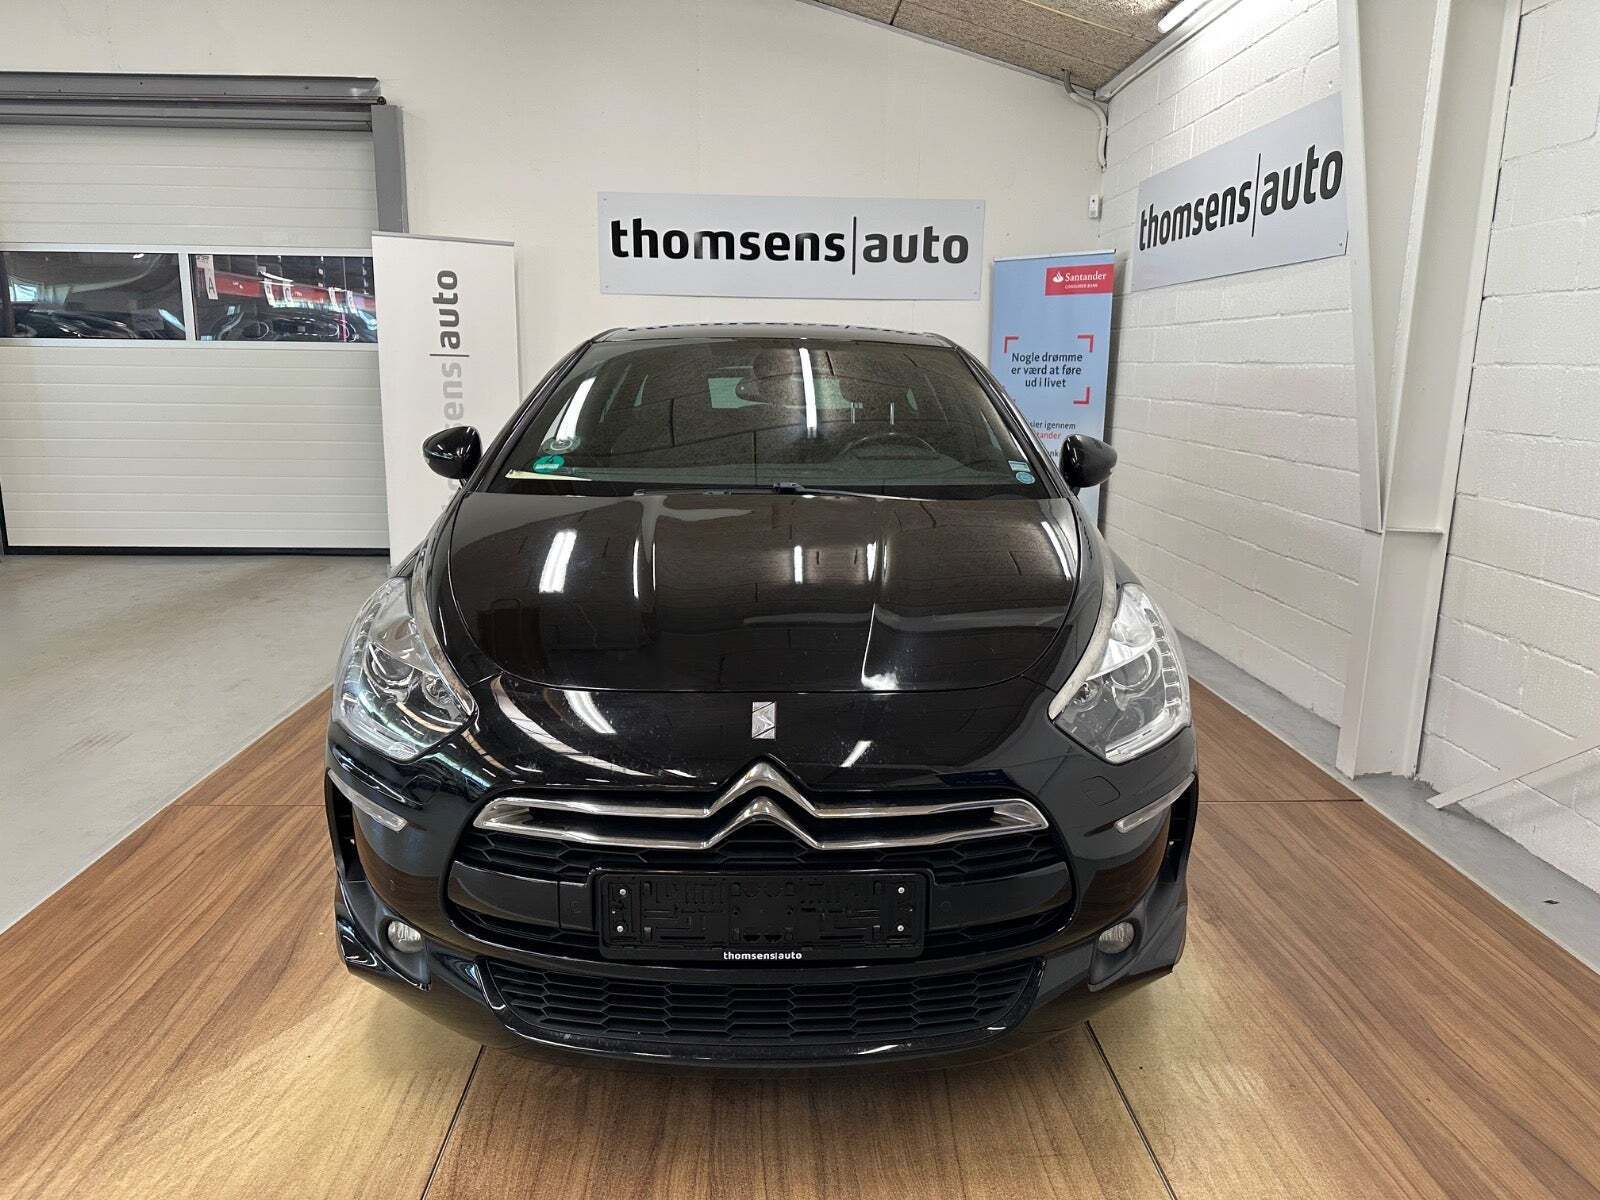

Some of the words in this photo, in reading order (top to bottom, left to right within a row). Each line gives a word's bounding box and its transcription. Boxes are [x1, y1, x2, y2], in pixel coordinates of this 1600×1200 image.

[1064, 270, 1107, 283] Santander
[432, 269, 461, 350] auto
[1011, 352, 1040, 364] Nogle
[1041, 352, 1083, 362] drømme
[1011, 367, 1021, 375] er
[1023, 364, 1047, 375] værd
[1049, 365, 1059, 375] at
[1062, 364, 1082, 375] føre
[1025, 377, 1037, 387] ud
[1044, 377, 1066, 388] livet
[1044, 420, 1076, 431] igennem
